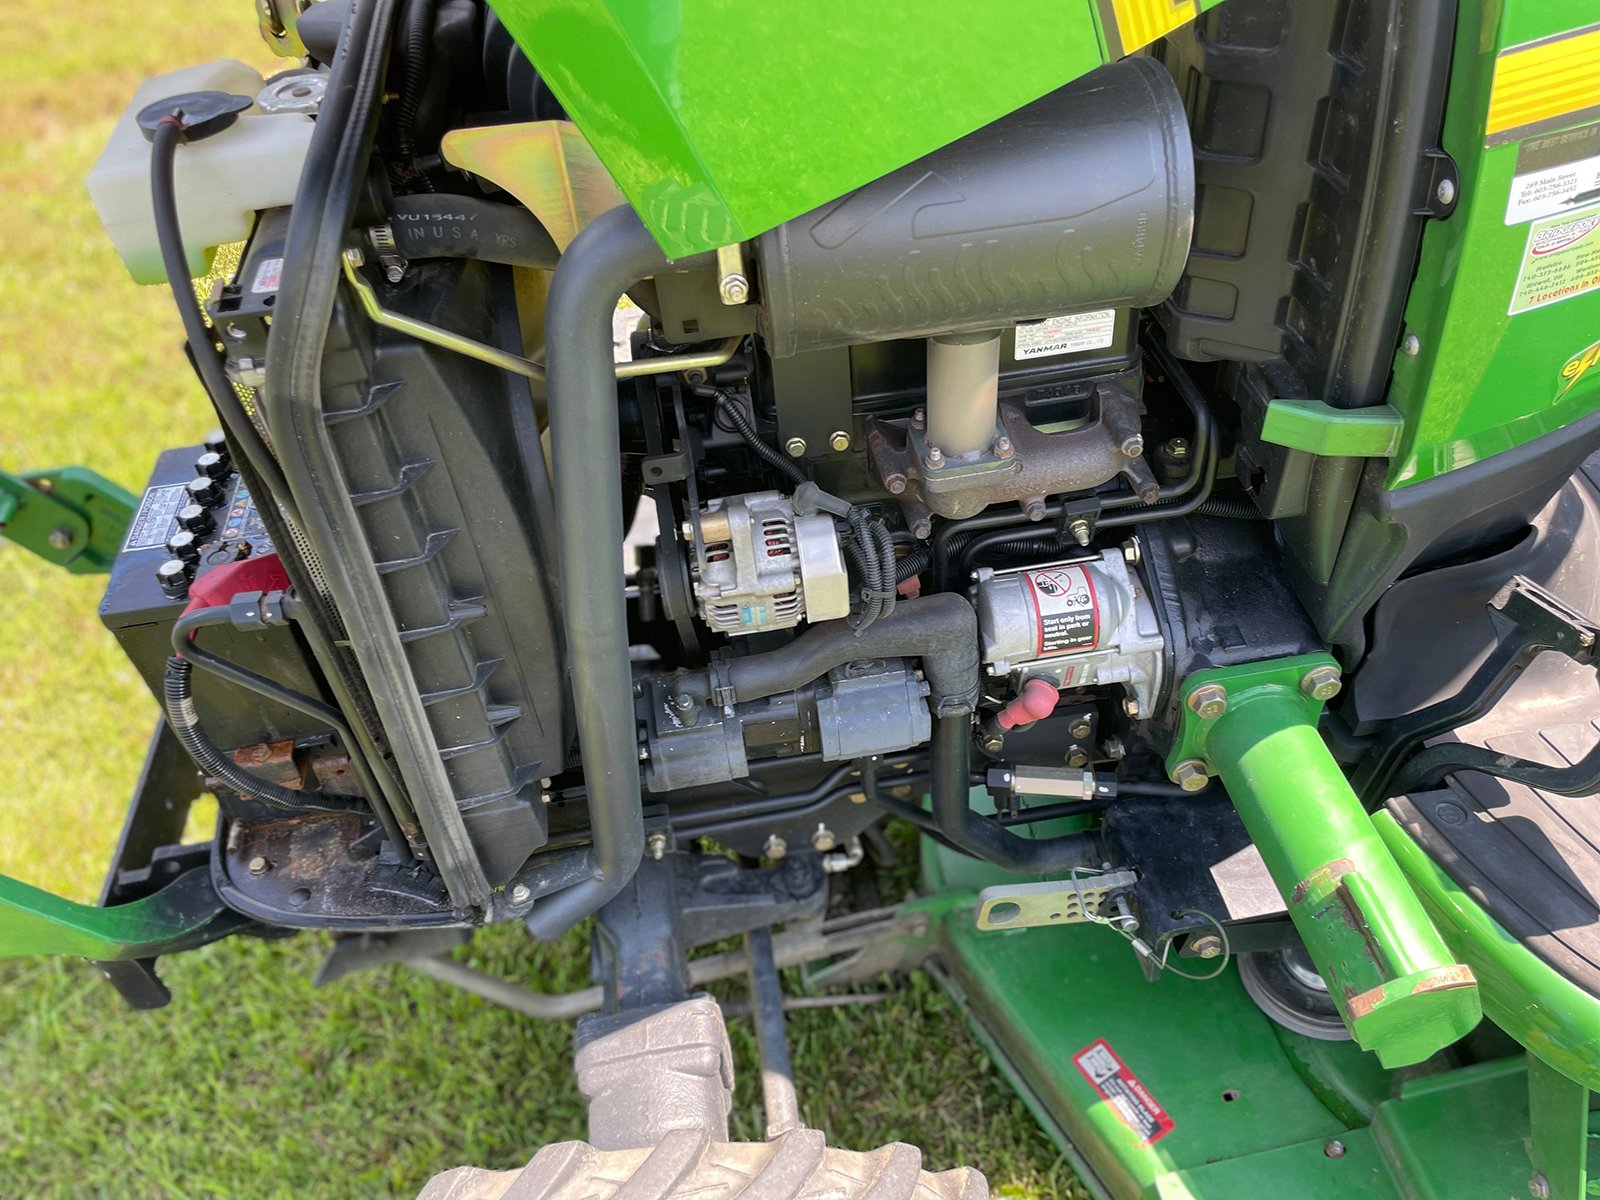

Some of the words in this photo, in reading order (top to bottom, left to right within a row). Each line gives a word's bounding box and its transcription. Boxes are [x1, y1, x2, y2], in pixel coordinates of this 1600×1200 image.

[1540, 177, 1556, 187] Main
[1558, 172, 1577, 182] Street
[1520, 190, 1532, 198] Tel:
[1517, 198, 1532, 206] Fax:
[408, 227, 424, 240] IN
[1528, 296, 1534, 304] 7
[1537, 284, 1579, 302] Locations
[1580, 280, 1589, 288] in
[1023, 343, 1068, 355] YANMAR
[1043, 618, 1059, 626] Start
[1066, 622, 1081, 630] park
[1043, 631, 1068, 639] neutral.
[1134, 1084, 1161, 1115] DANGER
